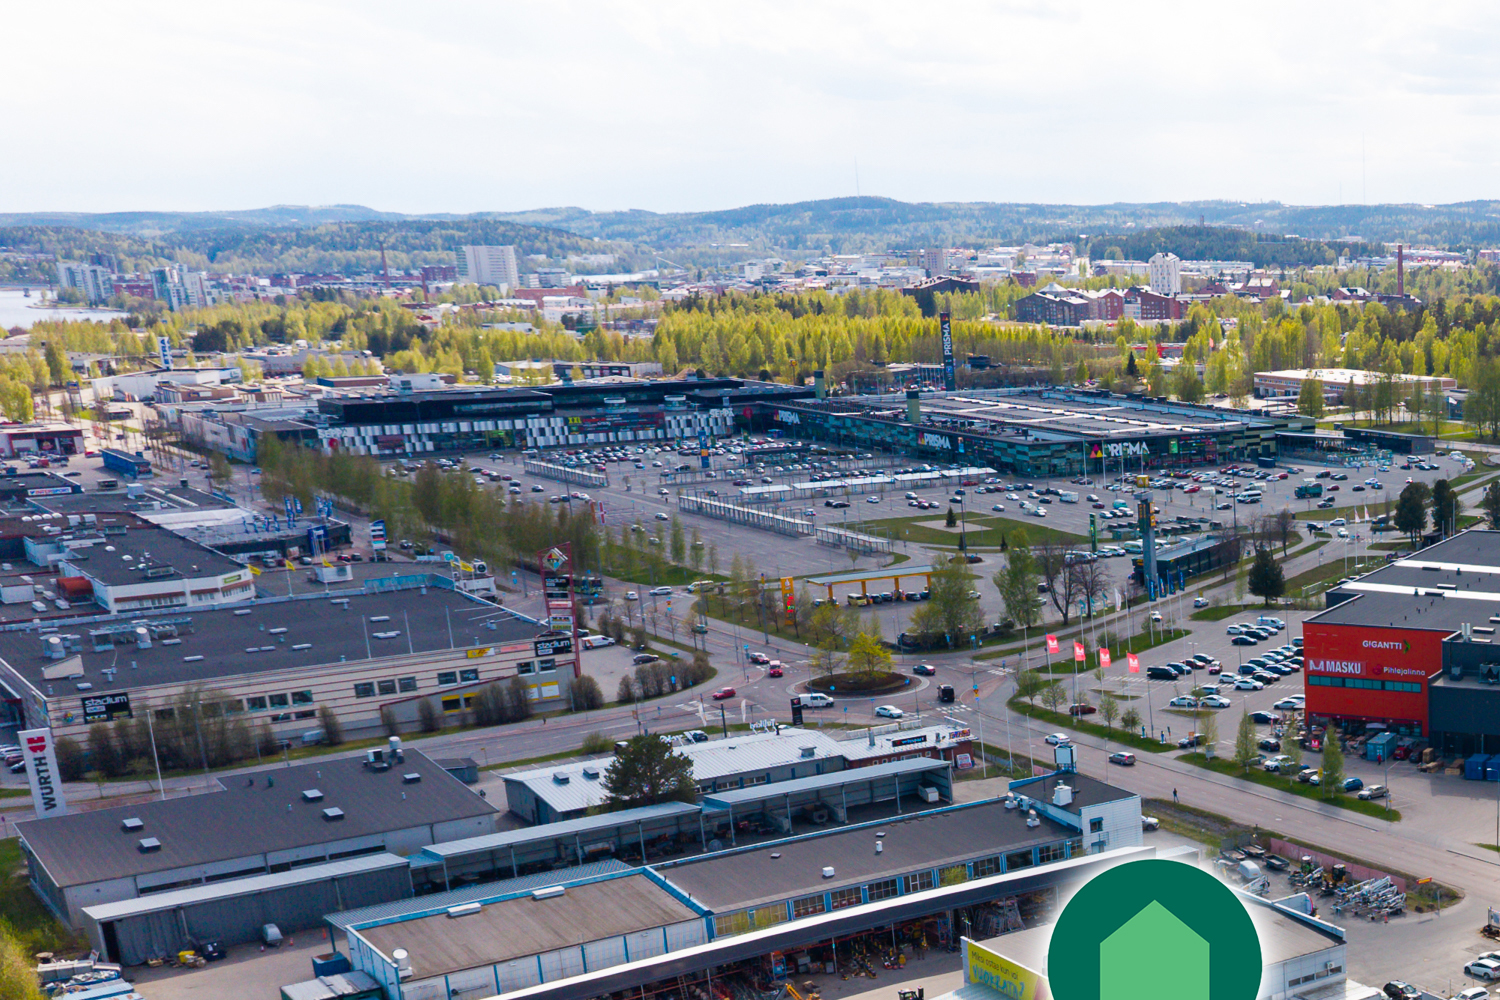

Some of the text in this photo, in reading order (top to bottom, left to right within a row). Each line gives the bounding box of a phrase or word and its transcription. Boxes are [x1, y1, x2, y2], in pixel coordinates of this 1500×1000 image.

[942, 322, 952, 355] PRISMA
[778, 410, 800, 424] PRISMA
[924, 432, 951, 449] PRISMA
[1362, 640, 1402, 650] GIGANTTI
[1326, 660, 1361, 674] MASKU
[1383, 666, 1425, 676] Pihlajalinna
[85, 695, 127, 706] stadium
[34, 756, 57, 811] WÜRTH
[971, 951, 984, 963] Miksi
[986, 959, 999, 970] ostaa
[1000, 964, 1009, 975] kun
